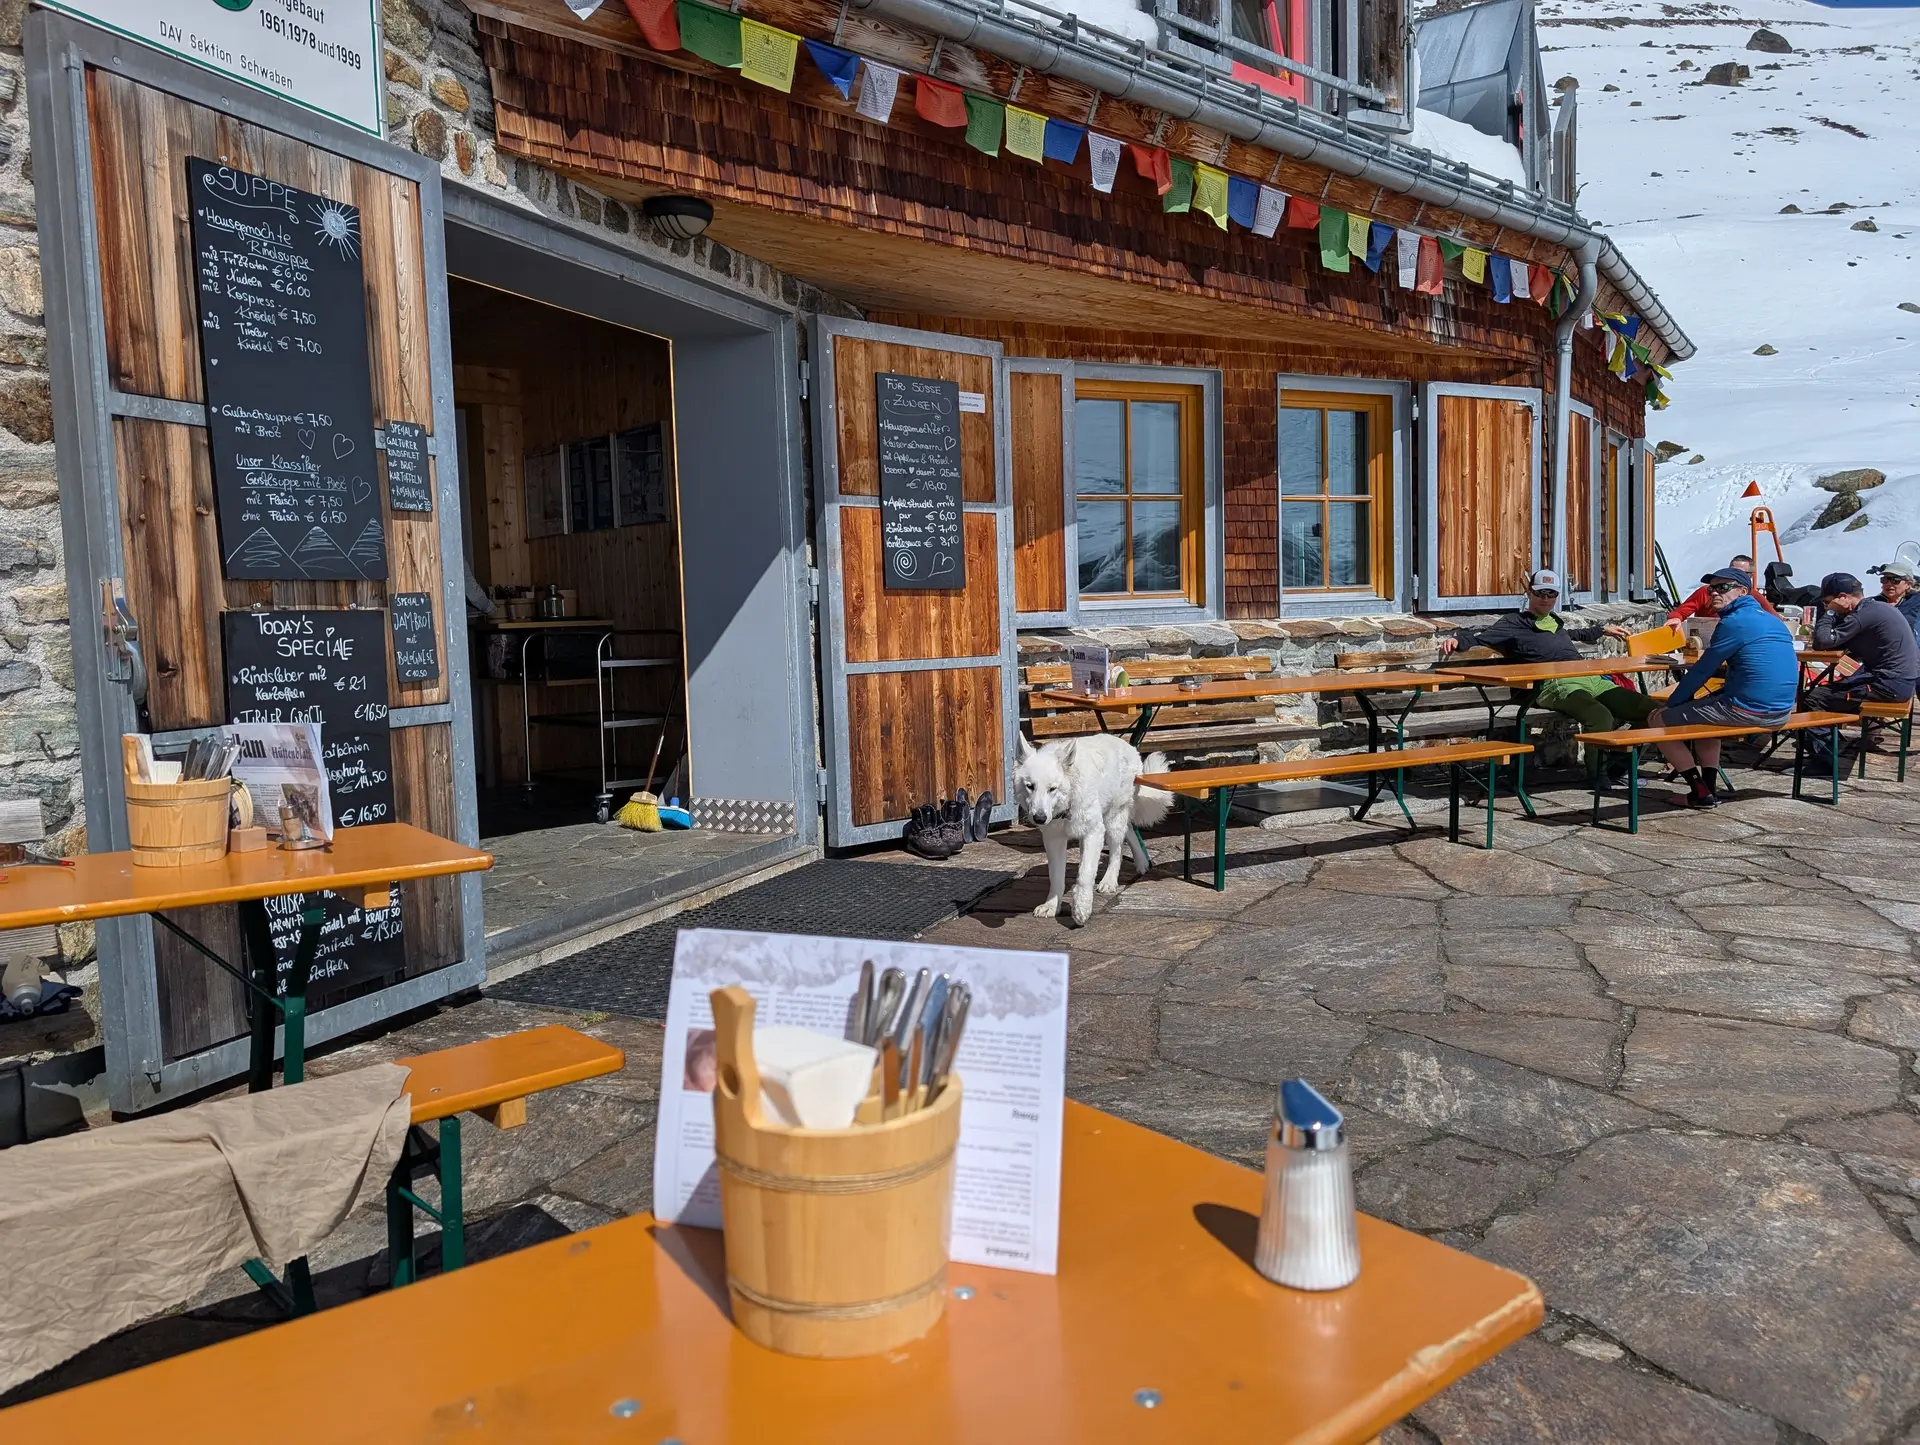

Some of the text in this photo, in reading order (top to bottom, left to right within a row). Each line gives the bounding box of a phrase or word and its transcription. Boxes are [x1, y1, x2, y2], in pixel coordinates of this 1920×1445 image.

[274, 0, 324, 24] gebaut
[159, 21, 293, 89] DAV Sektion Schwaben
[317, 40, 335, 58] und
[336, 45, 361, 69] 1999
[218, 167, 298, 212] SUPPE
[206, 207, 292, 245] Hausgemachte
[247, 240, 309, 270] Rindsuppe
[226, 268, 262, 288] Nudeln
[885, 378, 941, 395] FÜR SÜSSE
[235, 453, 322, 472] Unser Klassiker
[251, 613, 314, 635] TODAY'S
[276, 637, 354, 660] SPECIALE
[238, 665, 304, 685] Rindsleber
[348, 676, 367, 691] 21
[255, 686, 306, 702] Kartoffeln
[319, 911, 346, 935] nödel
